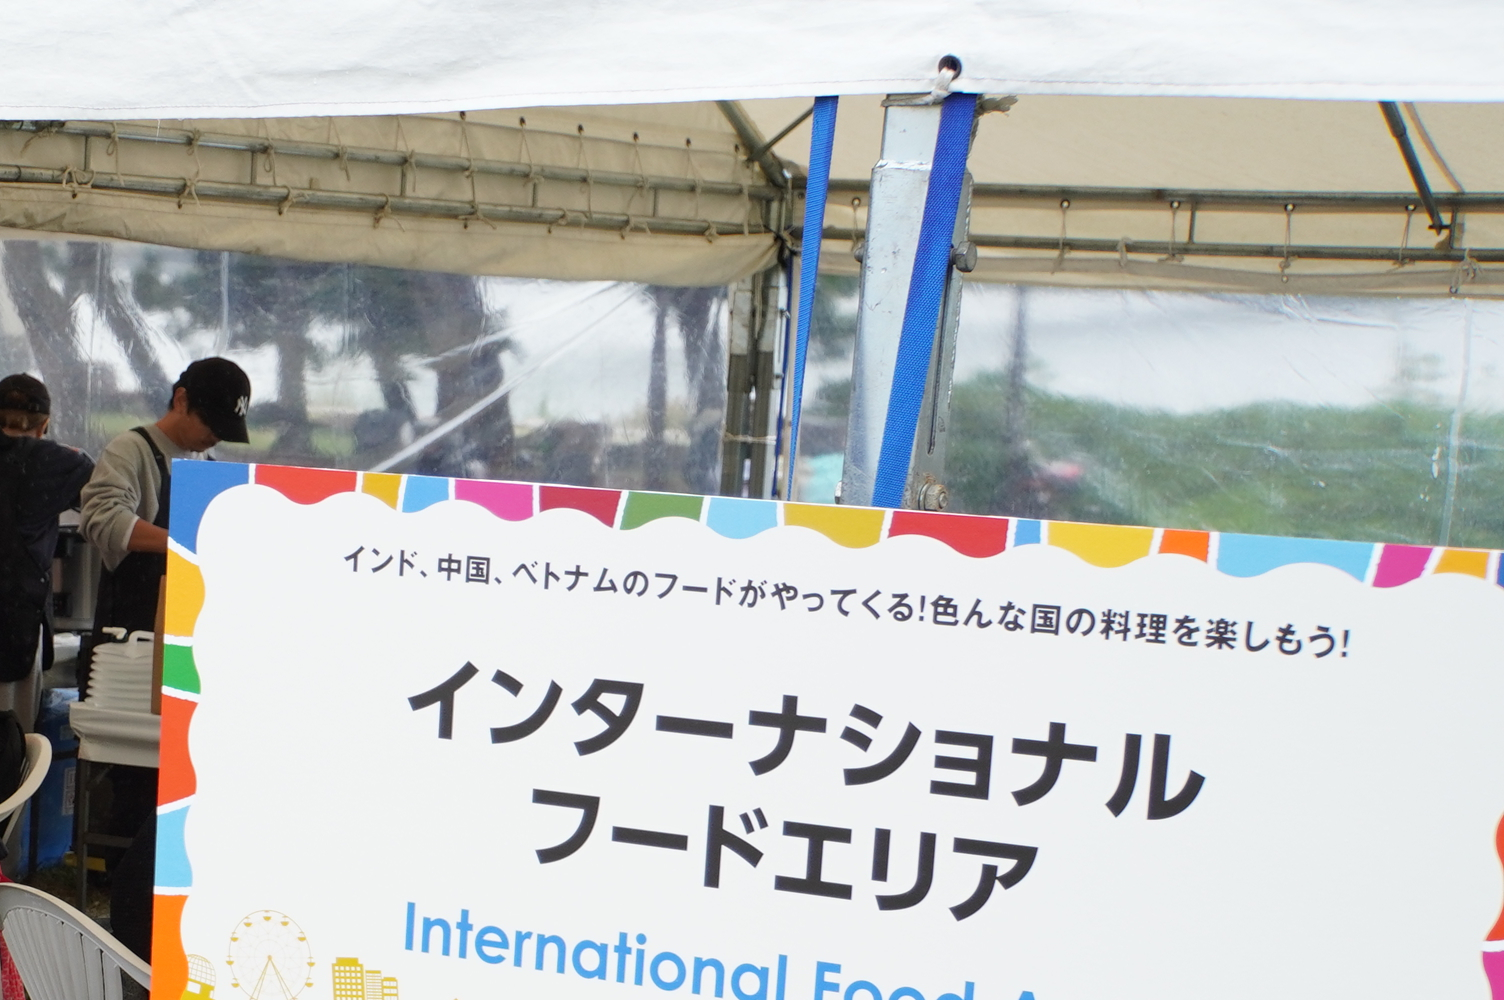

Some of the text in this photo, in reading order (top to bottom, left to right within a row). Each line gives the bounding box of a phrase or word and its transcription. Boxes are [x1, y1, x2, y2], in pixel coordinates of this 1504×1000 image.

[407, 660, 1206, 821] インターナショナル
[532, 788, 1039, 922] フードエリア
